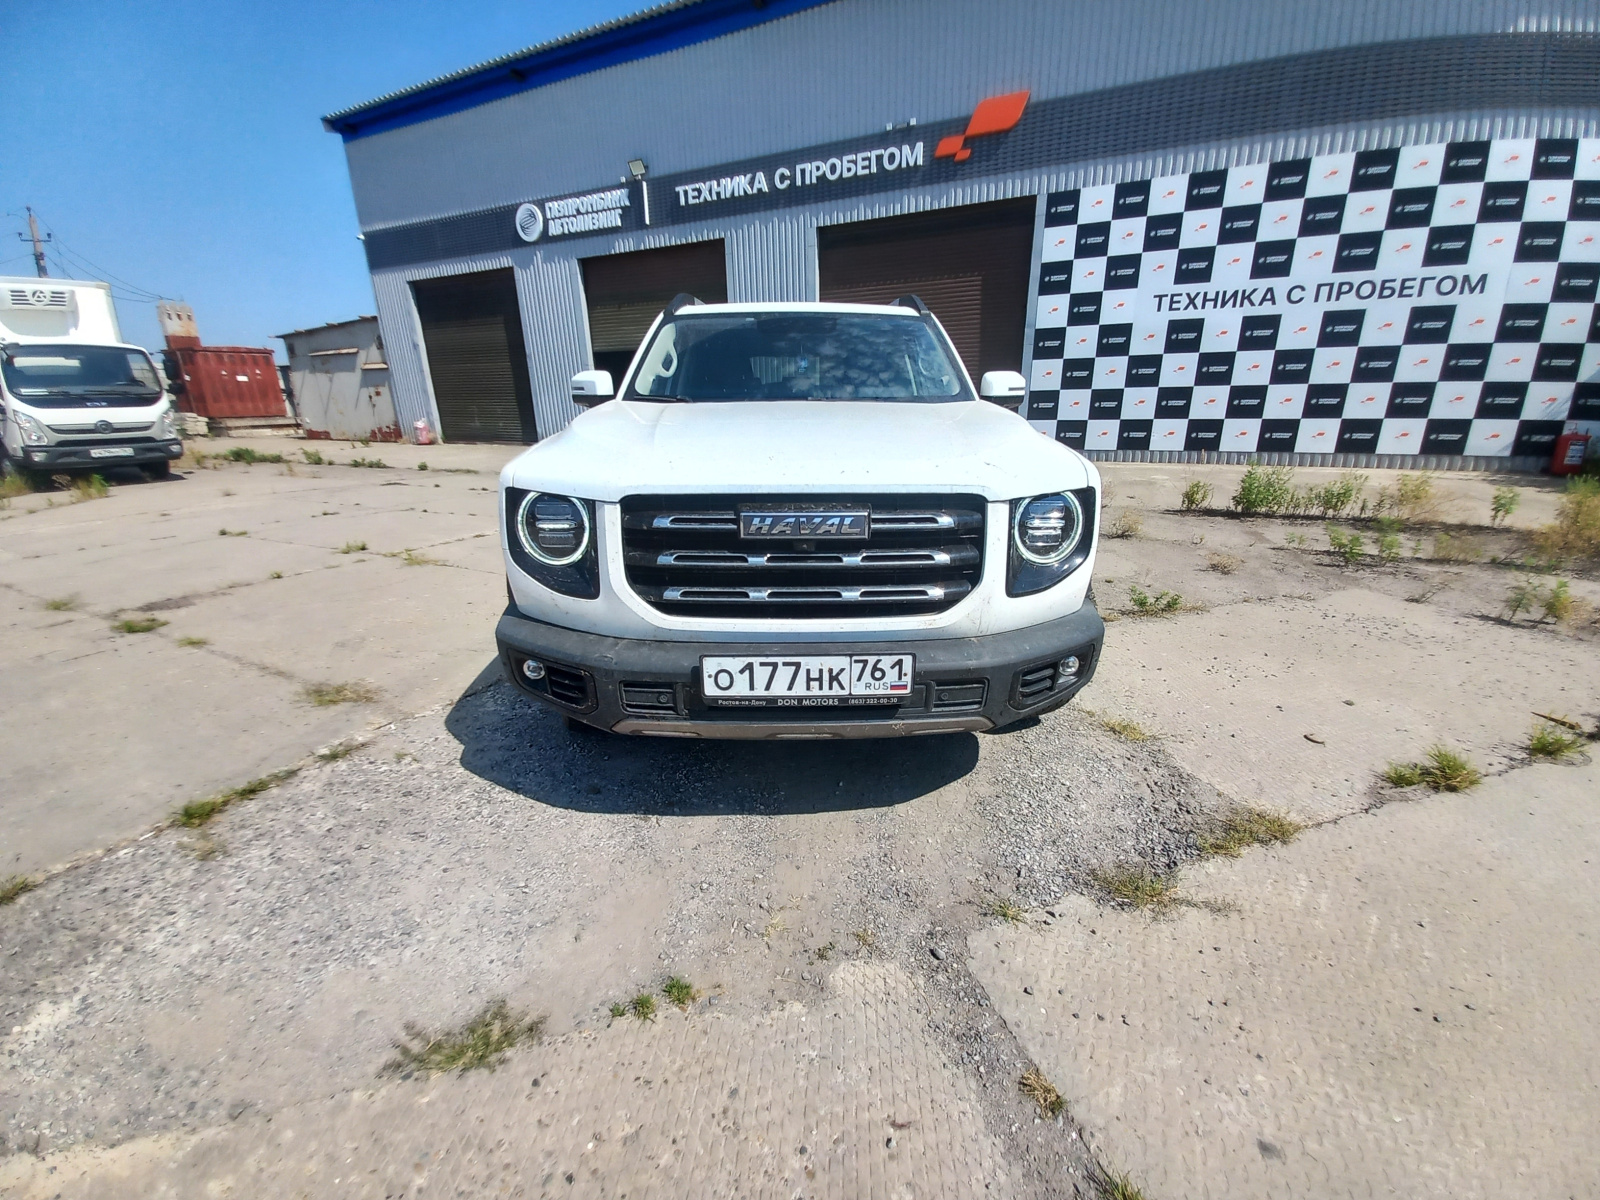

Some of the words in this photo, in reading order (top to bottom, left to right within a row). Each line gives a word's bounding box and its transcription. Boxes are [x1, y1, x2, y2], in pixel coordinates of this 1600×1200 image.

[675, 172, 768, 206] ТЕХНИКА
[774, 167, 790, 189] С
[796, 141, 924, 187] ПРОБЕГОМ
[545, 188, 630, 219] ГАЗПРОМБАНК
[548, 208, 622, 236] АВТОЛИЗИНГ
[1153, 286, 1277, 312] ТЕХНИКА
[1286, 284, 1306, 305] С
[1313, 273, 1488, 303] ПРОБЕГОМ
[748, 517, 861, 535] HAVAL
[853, 658, 905, 682] 761
[864, 681, 889, 691] RUS
[777, 698, 798, 706] DON
[802, 698, 839, 706] MOTORS
